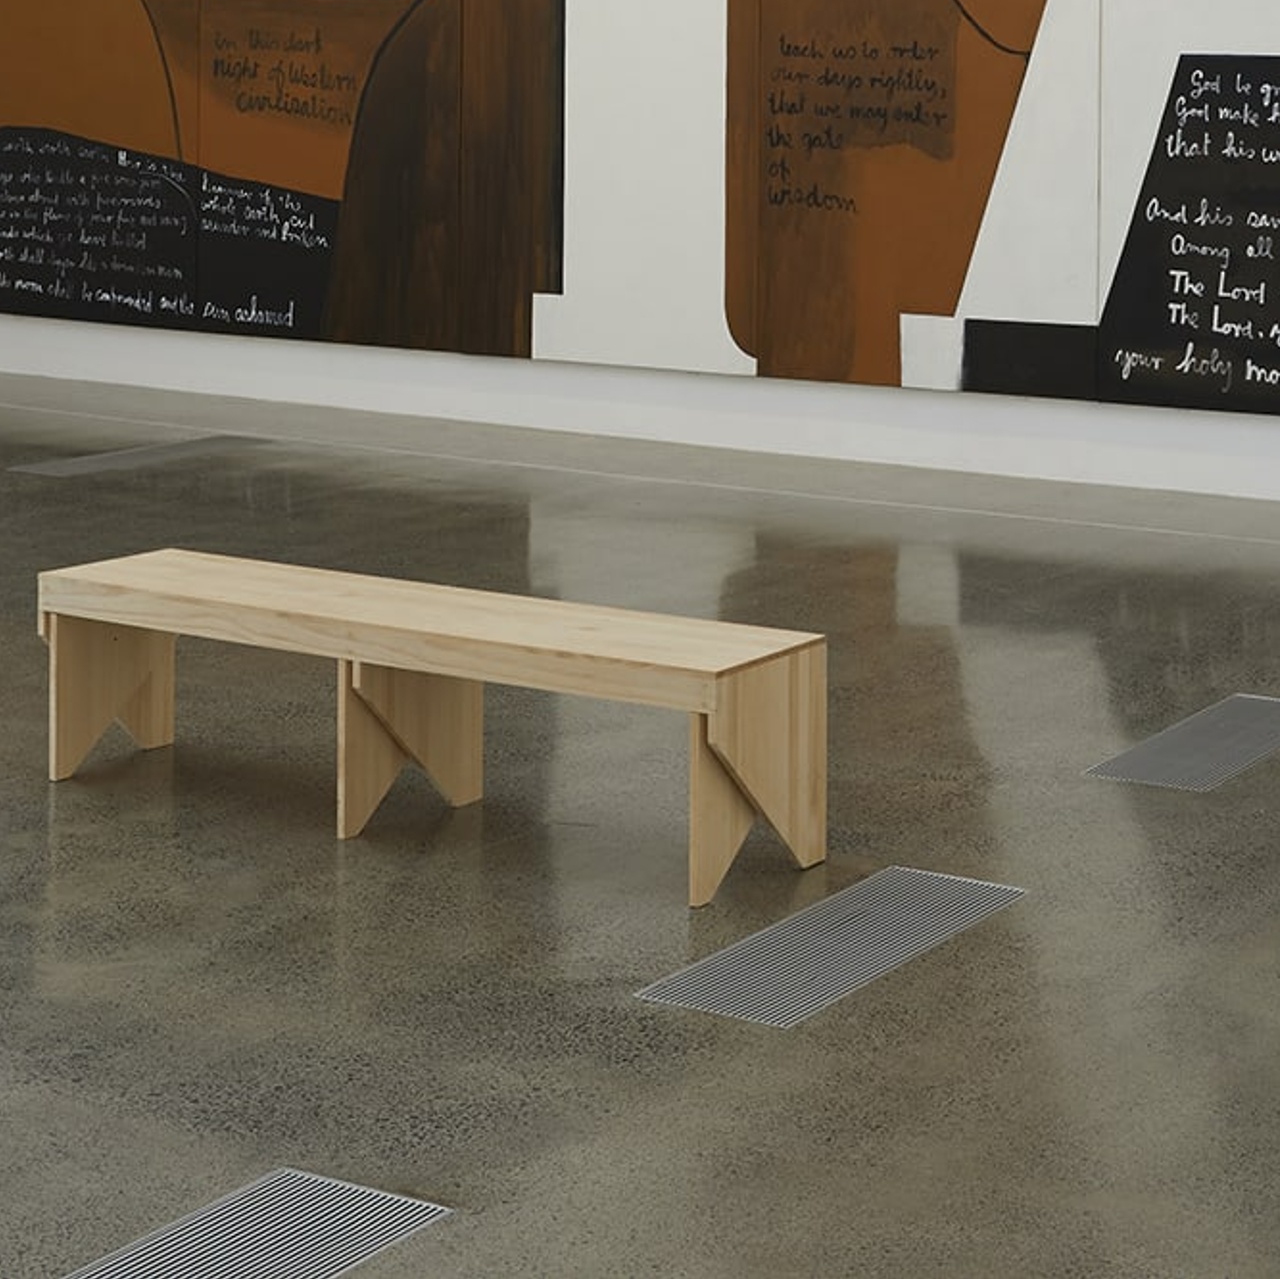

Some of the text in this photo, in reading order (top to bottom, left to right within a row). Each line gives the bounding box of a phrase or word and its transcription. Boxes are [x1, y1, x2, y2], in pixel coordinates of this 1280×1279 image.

[779, 35, 824, 59] teach
[832, 45, 857, 60] us
[862, 41, 879, 60] to
[771, 67, 808, 84] our
[817, 67, 863, 94] days
[1190, 69, 1221, 99] God
[1236, 73, 1252, 95] be
[768, 89, 947, 133] that we may enter
[1176, 96, 1210, 127] God
[1218, 102, 1260, 128] make
[767, 124, 843, 161] the gate
[1165, 128, 1211, 158] that
[1222, 131, 1256, 159] his
[768, 158, 791, 183] of
[768, 182, 858, 214] wisdom
[1146, 196, 1188, 225] And
[1193, 198, 1233, 226] his
[1170, 233, 1229, 269] Among
[1246, 235, 1274, 260] all
[1168, 270, 1206, 297] The
[1217, 270, 1266, 305] Lord
[1167, 302, 1200, 329] The
[1114, 349, 1164, 380] your
[1175, 341, 1234, 394] holy
